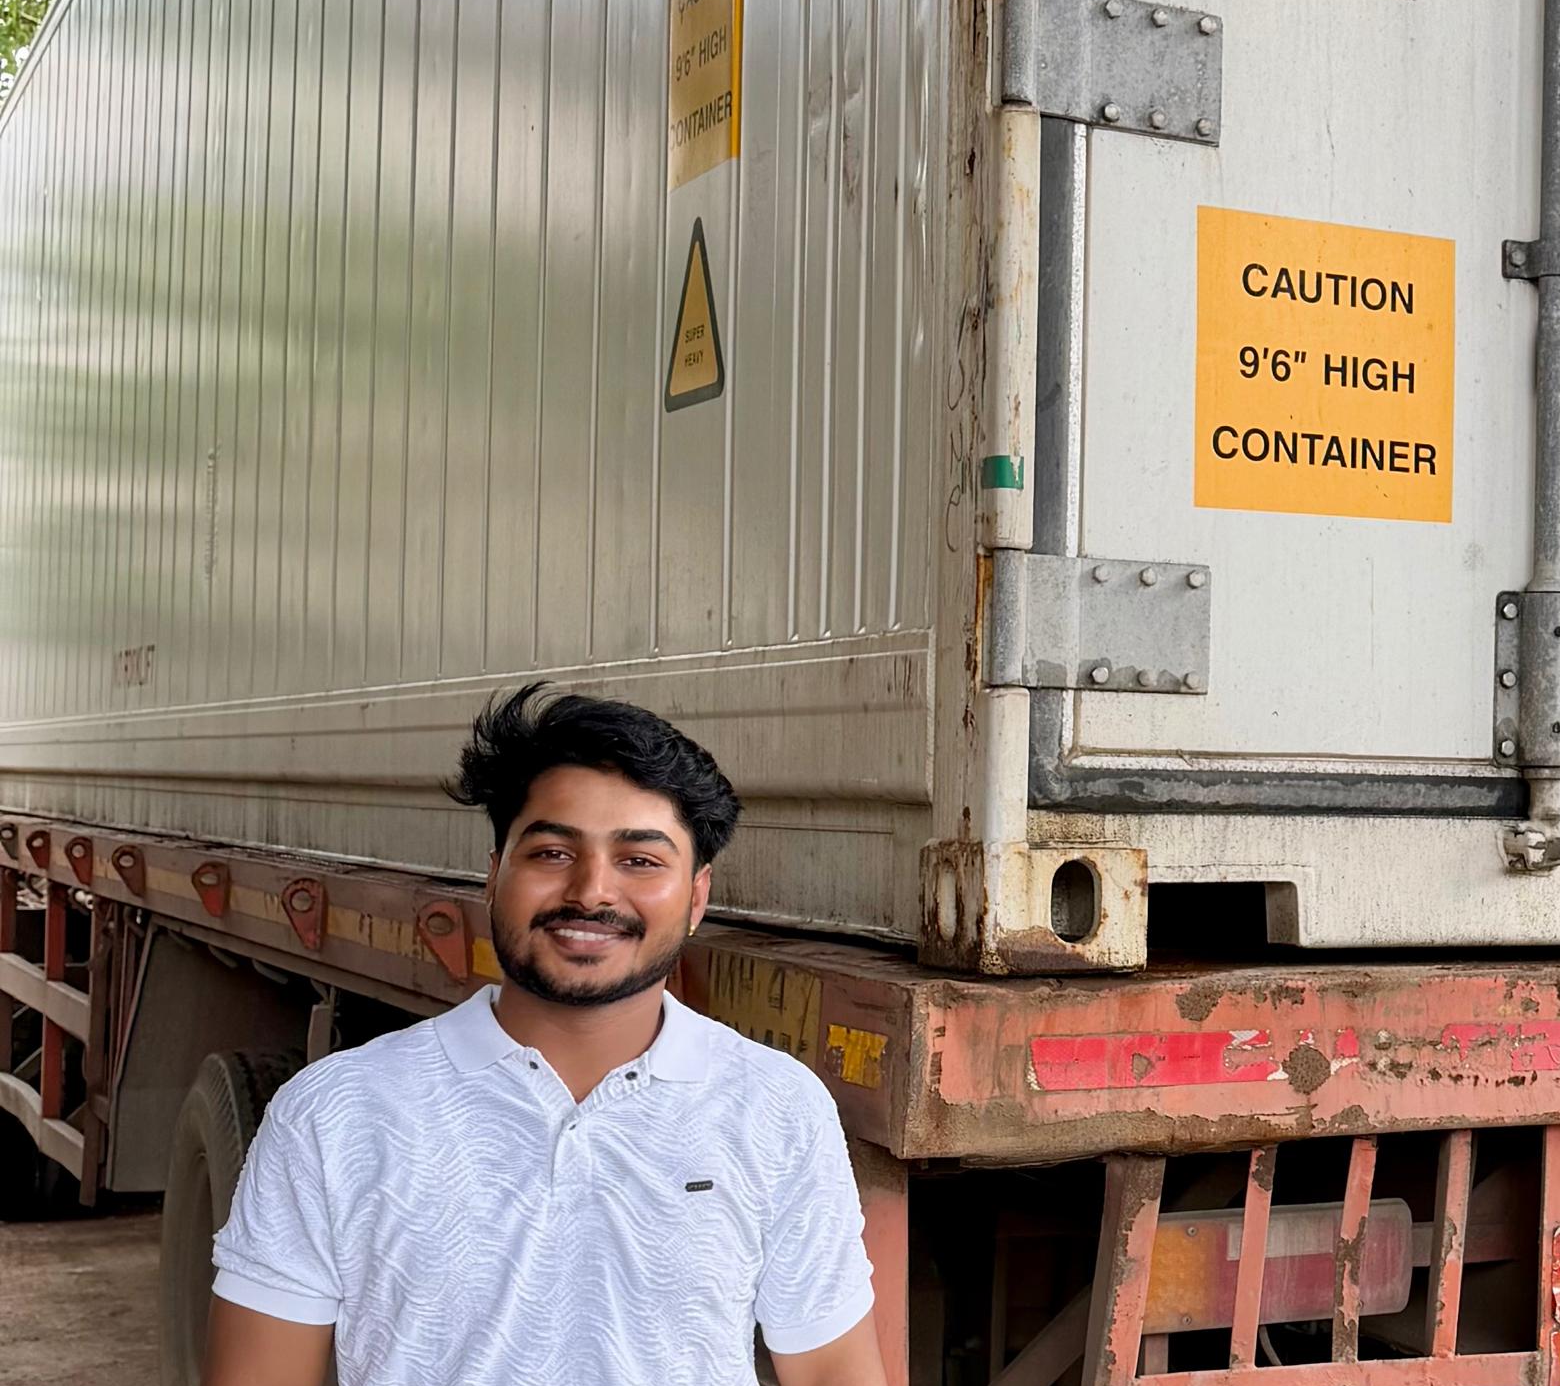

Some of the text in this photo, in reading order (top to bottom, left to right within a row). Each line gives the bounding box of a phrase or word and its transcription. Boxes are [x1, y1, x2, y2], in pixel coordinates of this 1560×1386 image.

[699, 25, 727, 68] HIGH
[1241, 263, 1414, 314] CAUTION
[1239, 345, 1416, 394] 9'6" HIGH
[1211, 425, 1438, 476] CONTAINER
